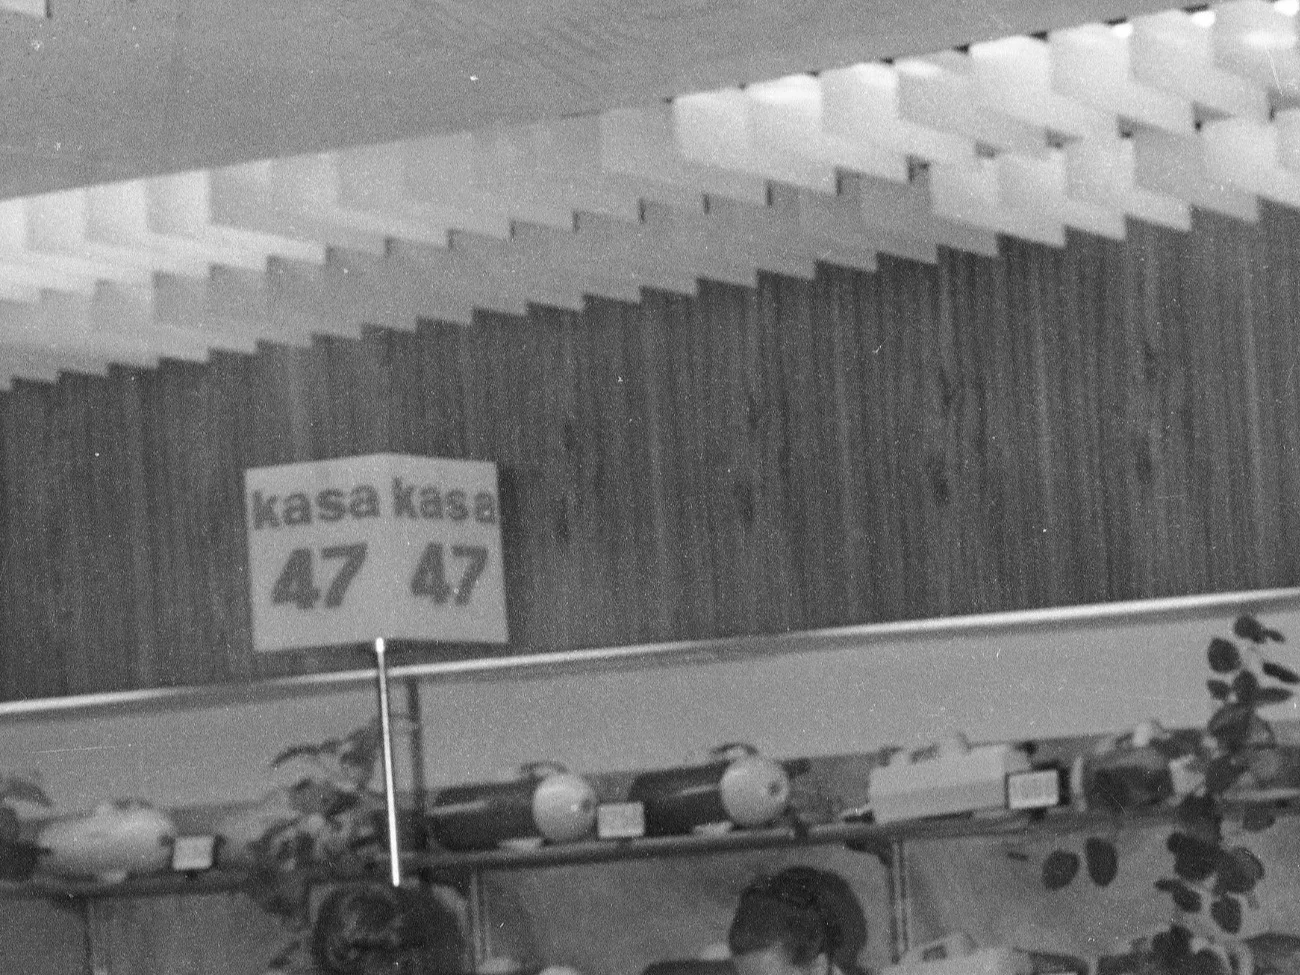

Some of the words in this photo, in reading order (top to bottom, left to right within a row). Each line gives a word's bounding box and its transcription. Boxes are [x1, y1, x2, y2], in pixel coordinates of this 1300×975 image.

[251, 485, 380, 530] kasa
[391, 477, 497, 524] kasa
[270, 542, 367, 609] 47
[410, 542, 488, 606] 47
